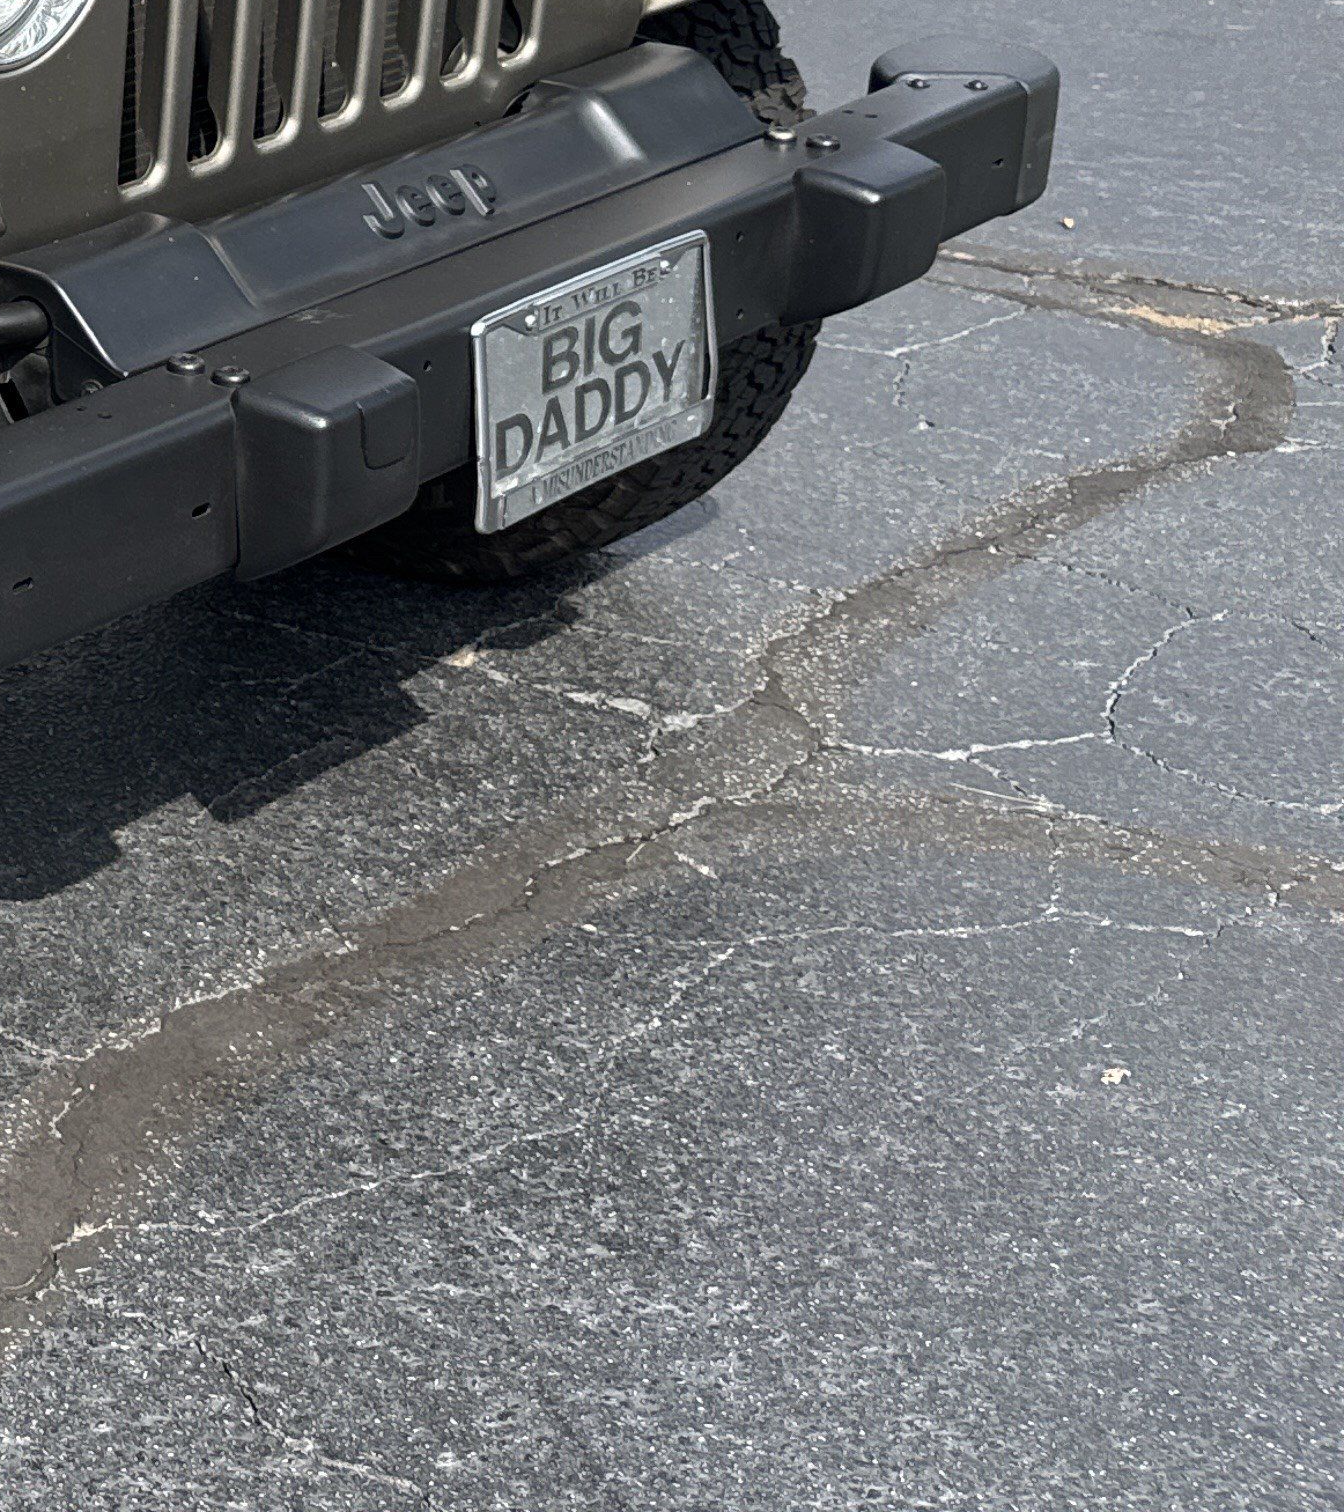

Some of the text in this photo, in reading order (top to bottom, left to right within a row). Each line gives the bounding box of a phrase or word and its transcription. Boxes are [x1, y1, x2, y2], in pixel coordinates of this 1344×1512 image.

[361, 163, 498, 240] Jeep
[542, 300, 643, 395] BIG
[495, 340, 686, 480] DADDY
